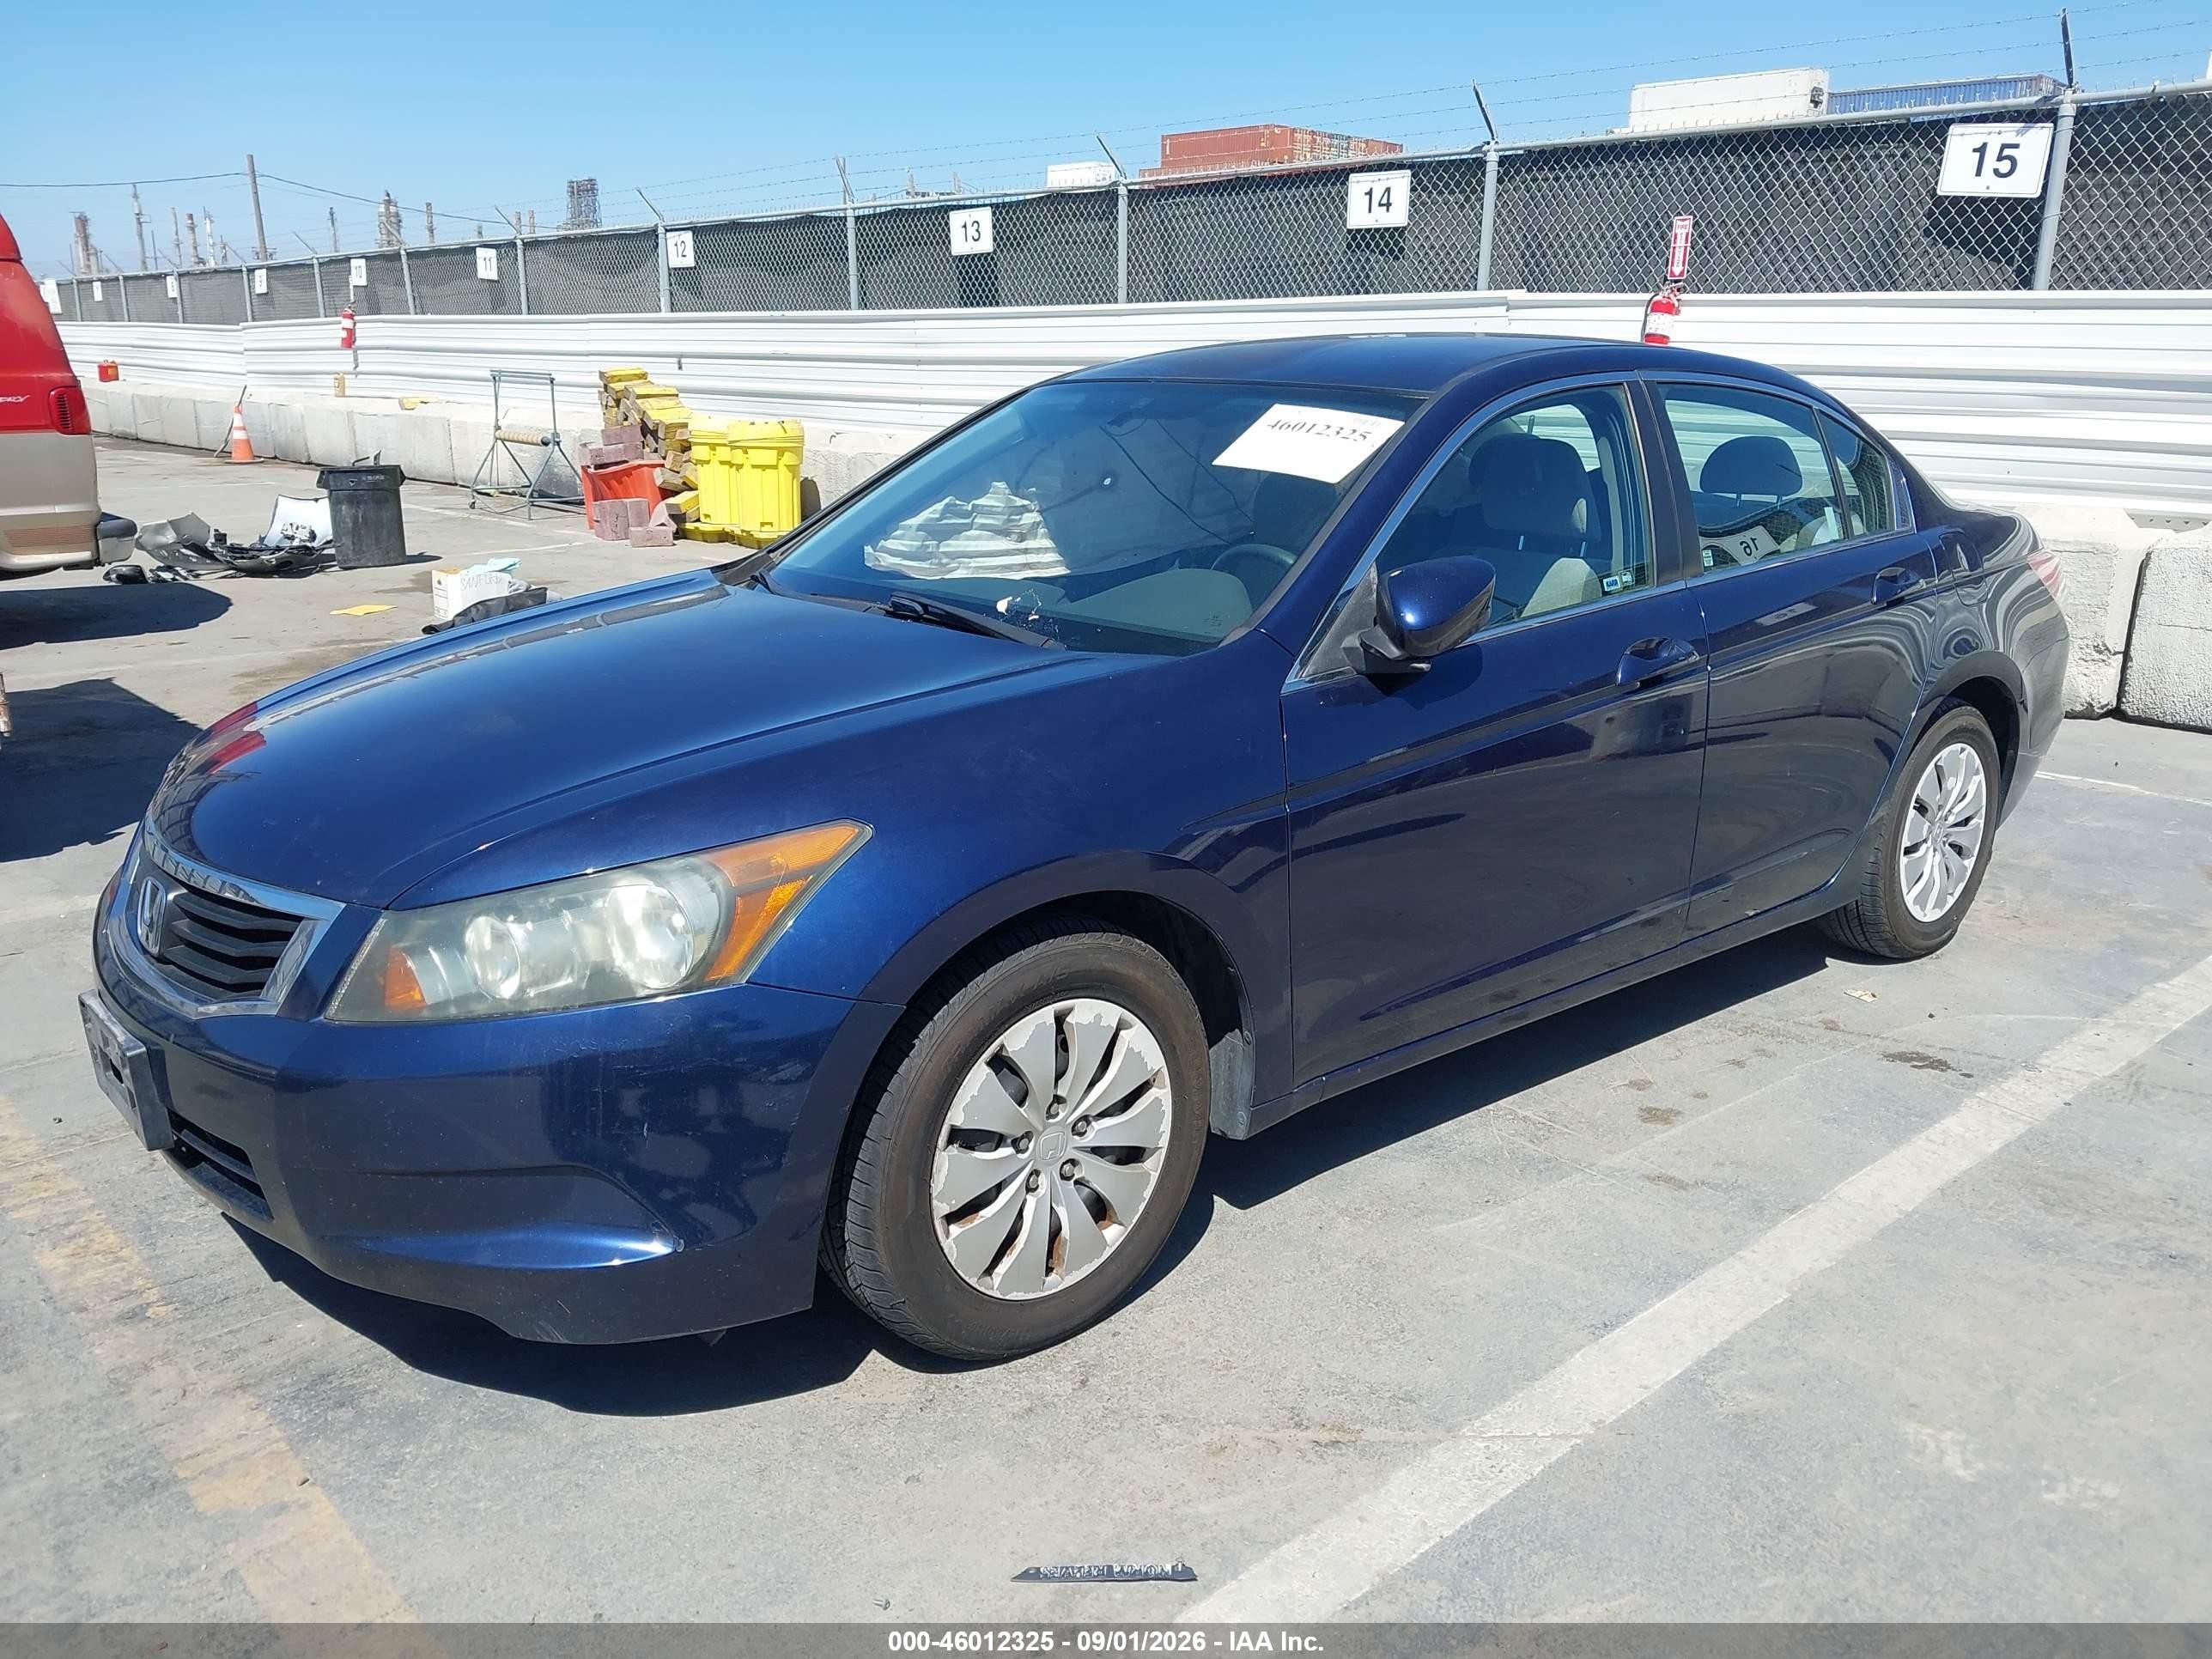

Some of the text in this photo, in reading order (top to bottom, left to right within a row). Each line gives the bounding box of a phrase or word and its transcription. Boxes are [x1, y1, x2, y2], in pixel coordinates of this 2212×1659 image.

[1972, 142, 2021, 179] 15
[1364, 186, 1394, 214] 14
[960, 220, 981, 242] 13
[673, 240, 687, 258] 12
[355, 265, 362, 279] 10
[483, 257, 493, 272] 11
[1267, 419, 1372, 441] 46012325
